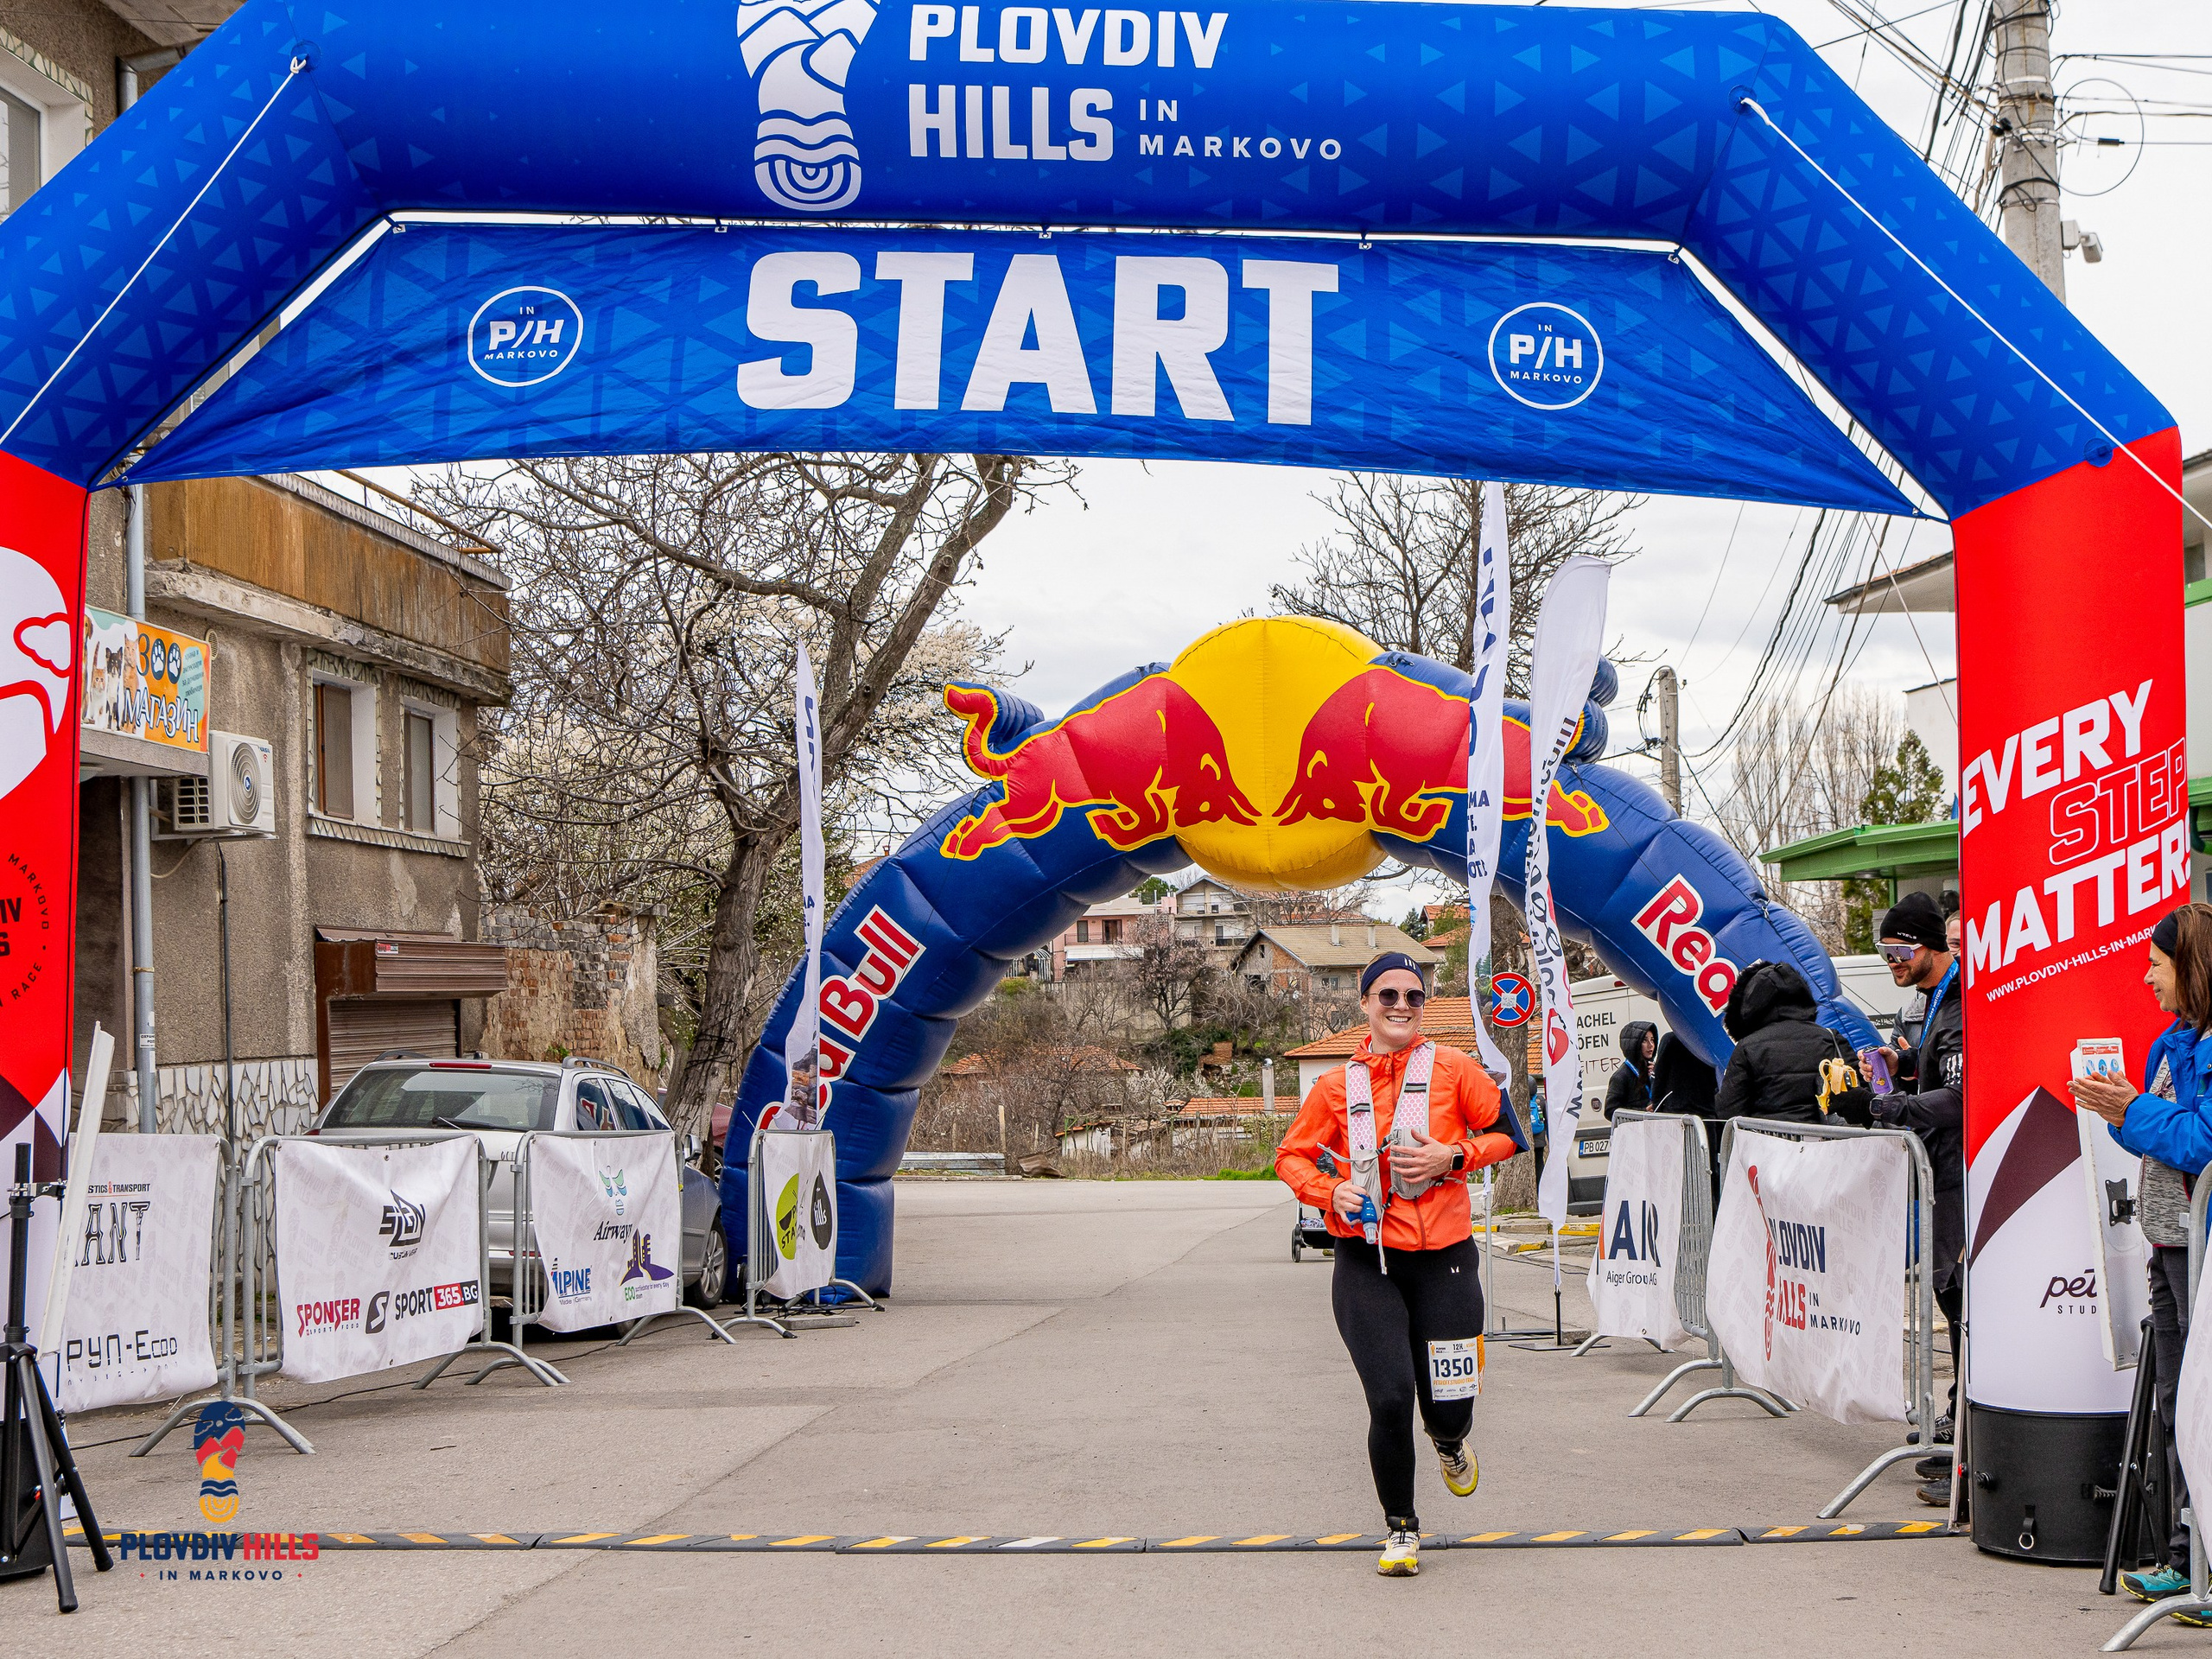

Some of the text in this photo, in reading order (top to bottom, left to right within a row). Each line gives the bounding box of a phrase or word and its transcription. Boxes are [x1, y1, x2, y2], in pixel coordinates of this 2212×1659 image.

[909, 5, 1228, 68] PLOVDIV
[909, 84, 1178, 161] HILLS IN
[1139, 134, 1343, 161] MARKOVO
[519, 306, 535, 315] IN
[1538, 324, 1553, 333] IN
[488, 319, 564, 351] P/H
[737, 251, 1338, 425] START
[1510, 334, 1582, 370] P/H
[484, 349, 558, 360] MARKOVO
[1510, 371, 1582, 385] MARKOVO
[124, 687, 200, 743] МАГАЗИН
[1963, 679, 2152, 838] EVERY
[2049, 737, 2186, 866] STEP
[819, 904, 926, 1043] Bull
[1986, 918, 2162, 1002] WWW.PLOVDIV-HILLS-IN-MARK
[1576, 1011, 1617, 1029] ACHEL
[74, 1201, 151, 1268] ANT
[1809, 1292, 1820, 1306] IN
[2057, 1305, 2097, 1314] STUD
[296, 1298, 360, 1338] SPONSER
[1433, 1357, 1474, 1378] 1350
